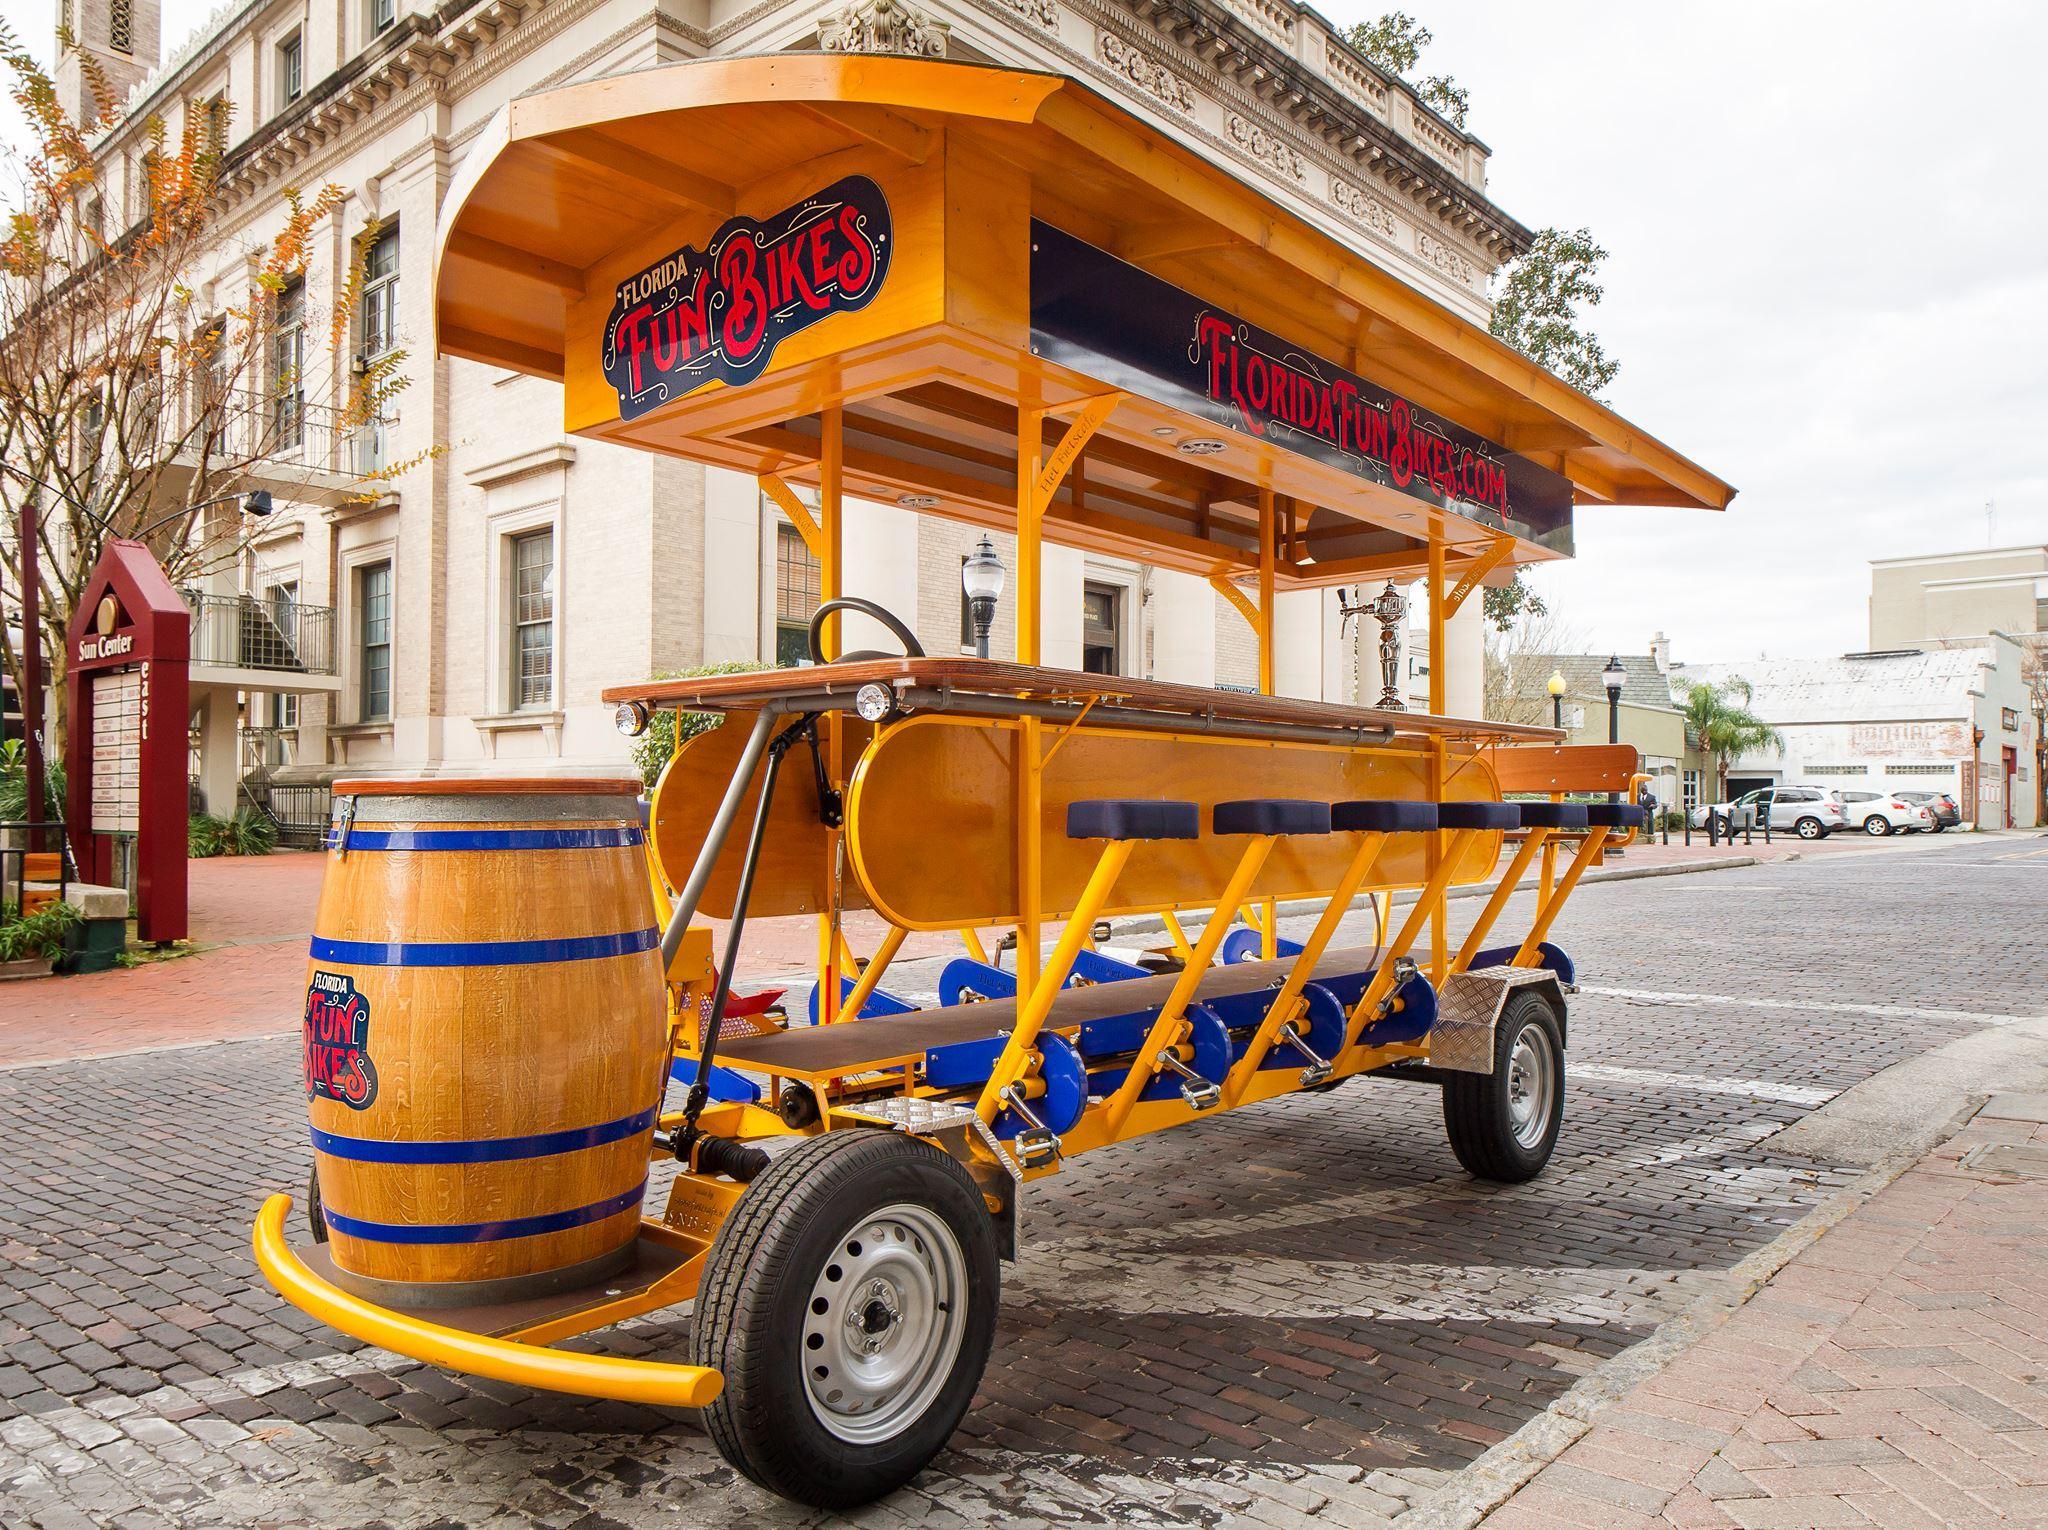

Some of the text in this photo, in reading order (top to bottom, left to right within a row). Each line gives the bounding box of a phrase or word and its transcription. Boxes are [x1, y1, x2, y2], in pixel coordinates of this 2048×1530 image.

[617, 205, 872, 393] FUN BIKES
[622, 254, 688, 309] FLORIDA
[79, 634, 132, 661] Sun Center
[141, 661, 149, 740] east
[314, 972, 348, 994] FLORIDA
[309, 992, 359, 1045] FUN
[303, 1019, 367, 1099] BIKES
